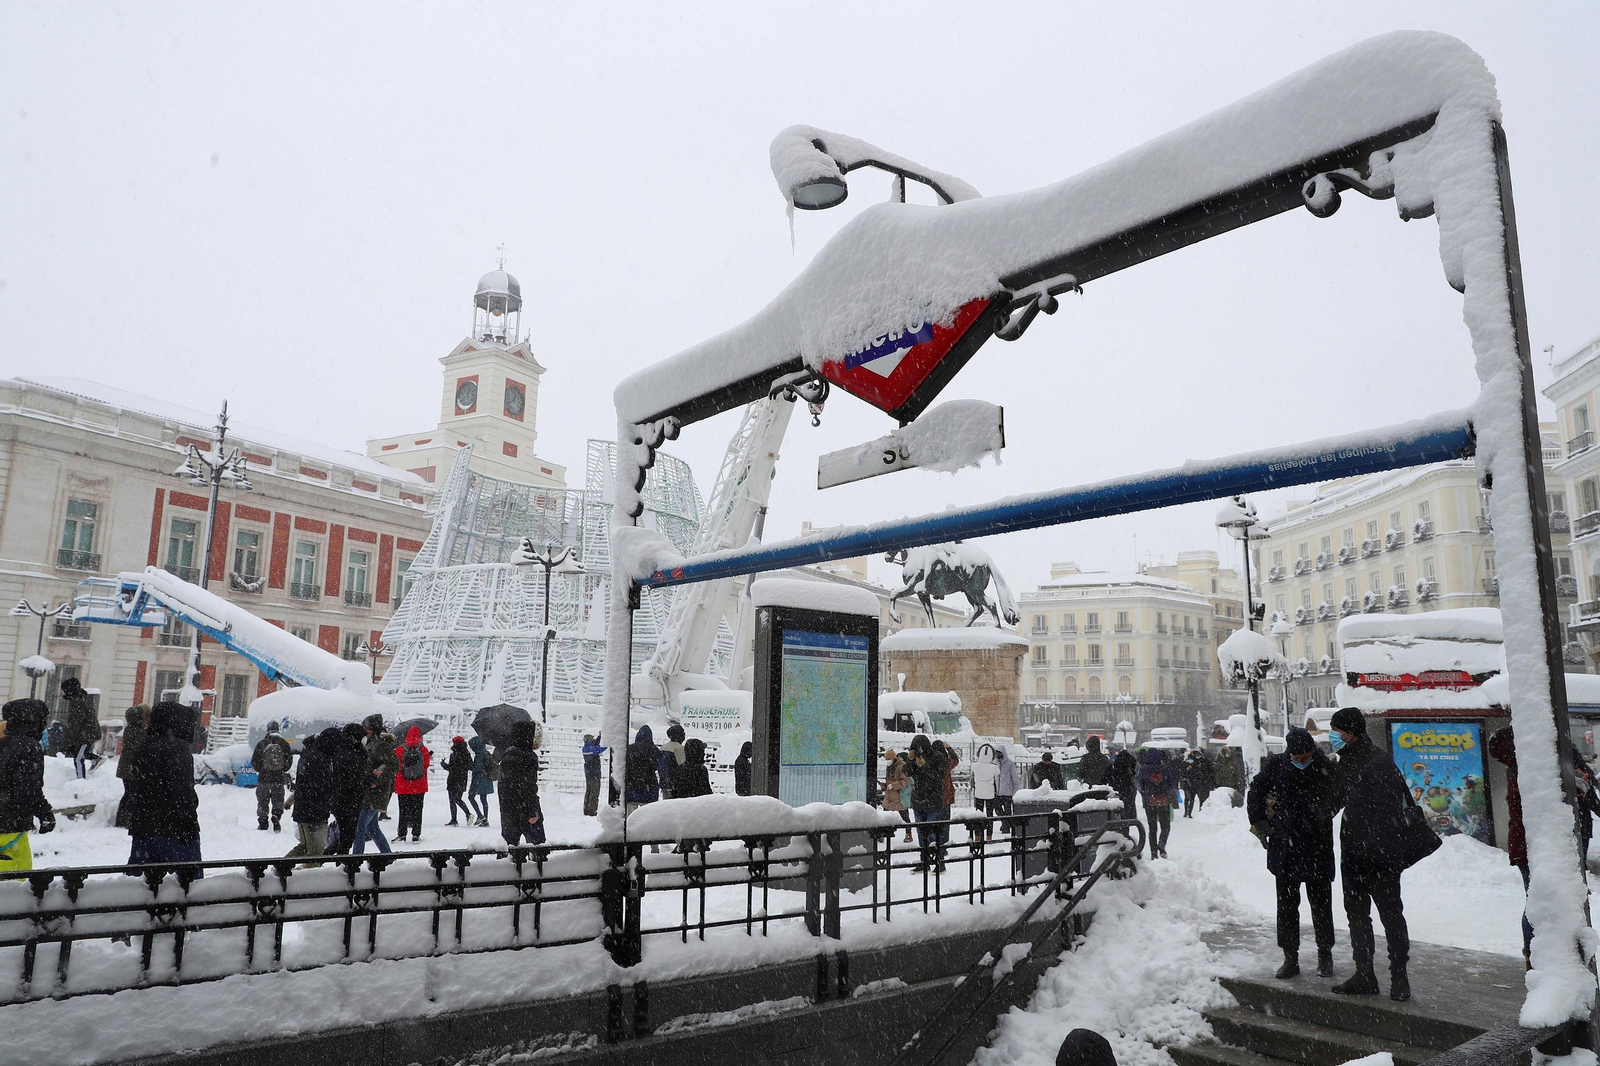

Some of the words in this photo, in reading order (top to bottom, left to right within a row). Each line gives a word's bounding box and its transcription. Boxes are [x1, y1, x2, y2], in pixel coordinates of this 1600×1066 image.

[1319, 452, 1337, 463] las
[1268, 457, 1318, 472] molestias
[723, 722, 732, 730] 00
[1398, 731, 1476, 750] CROODS
